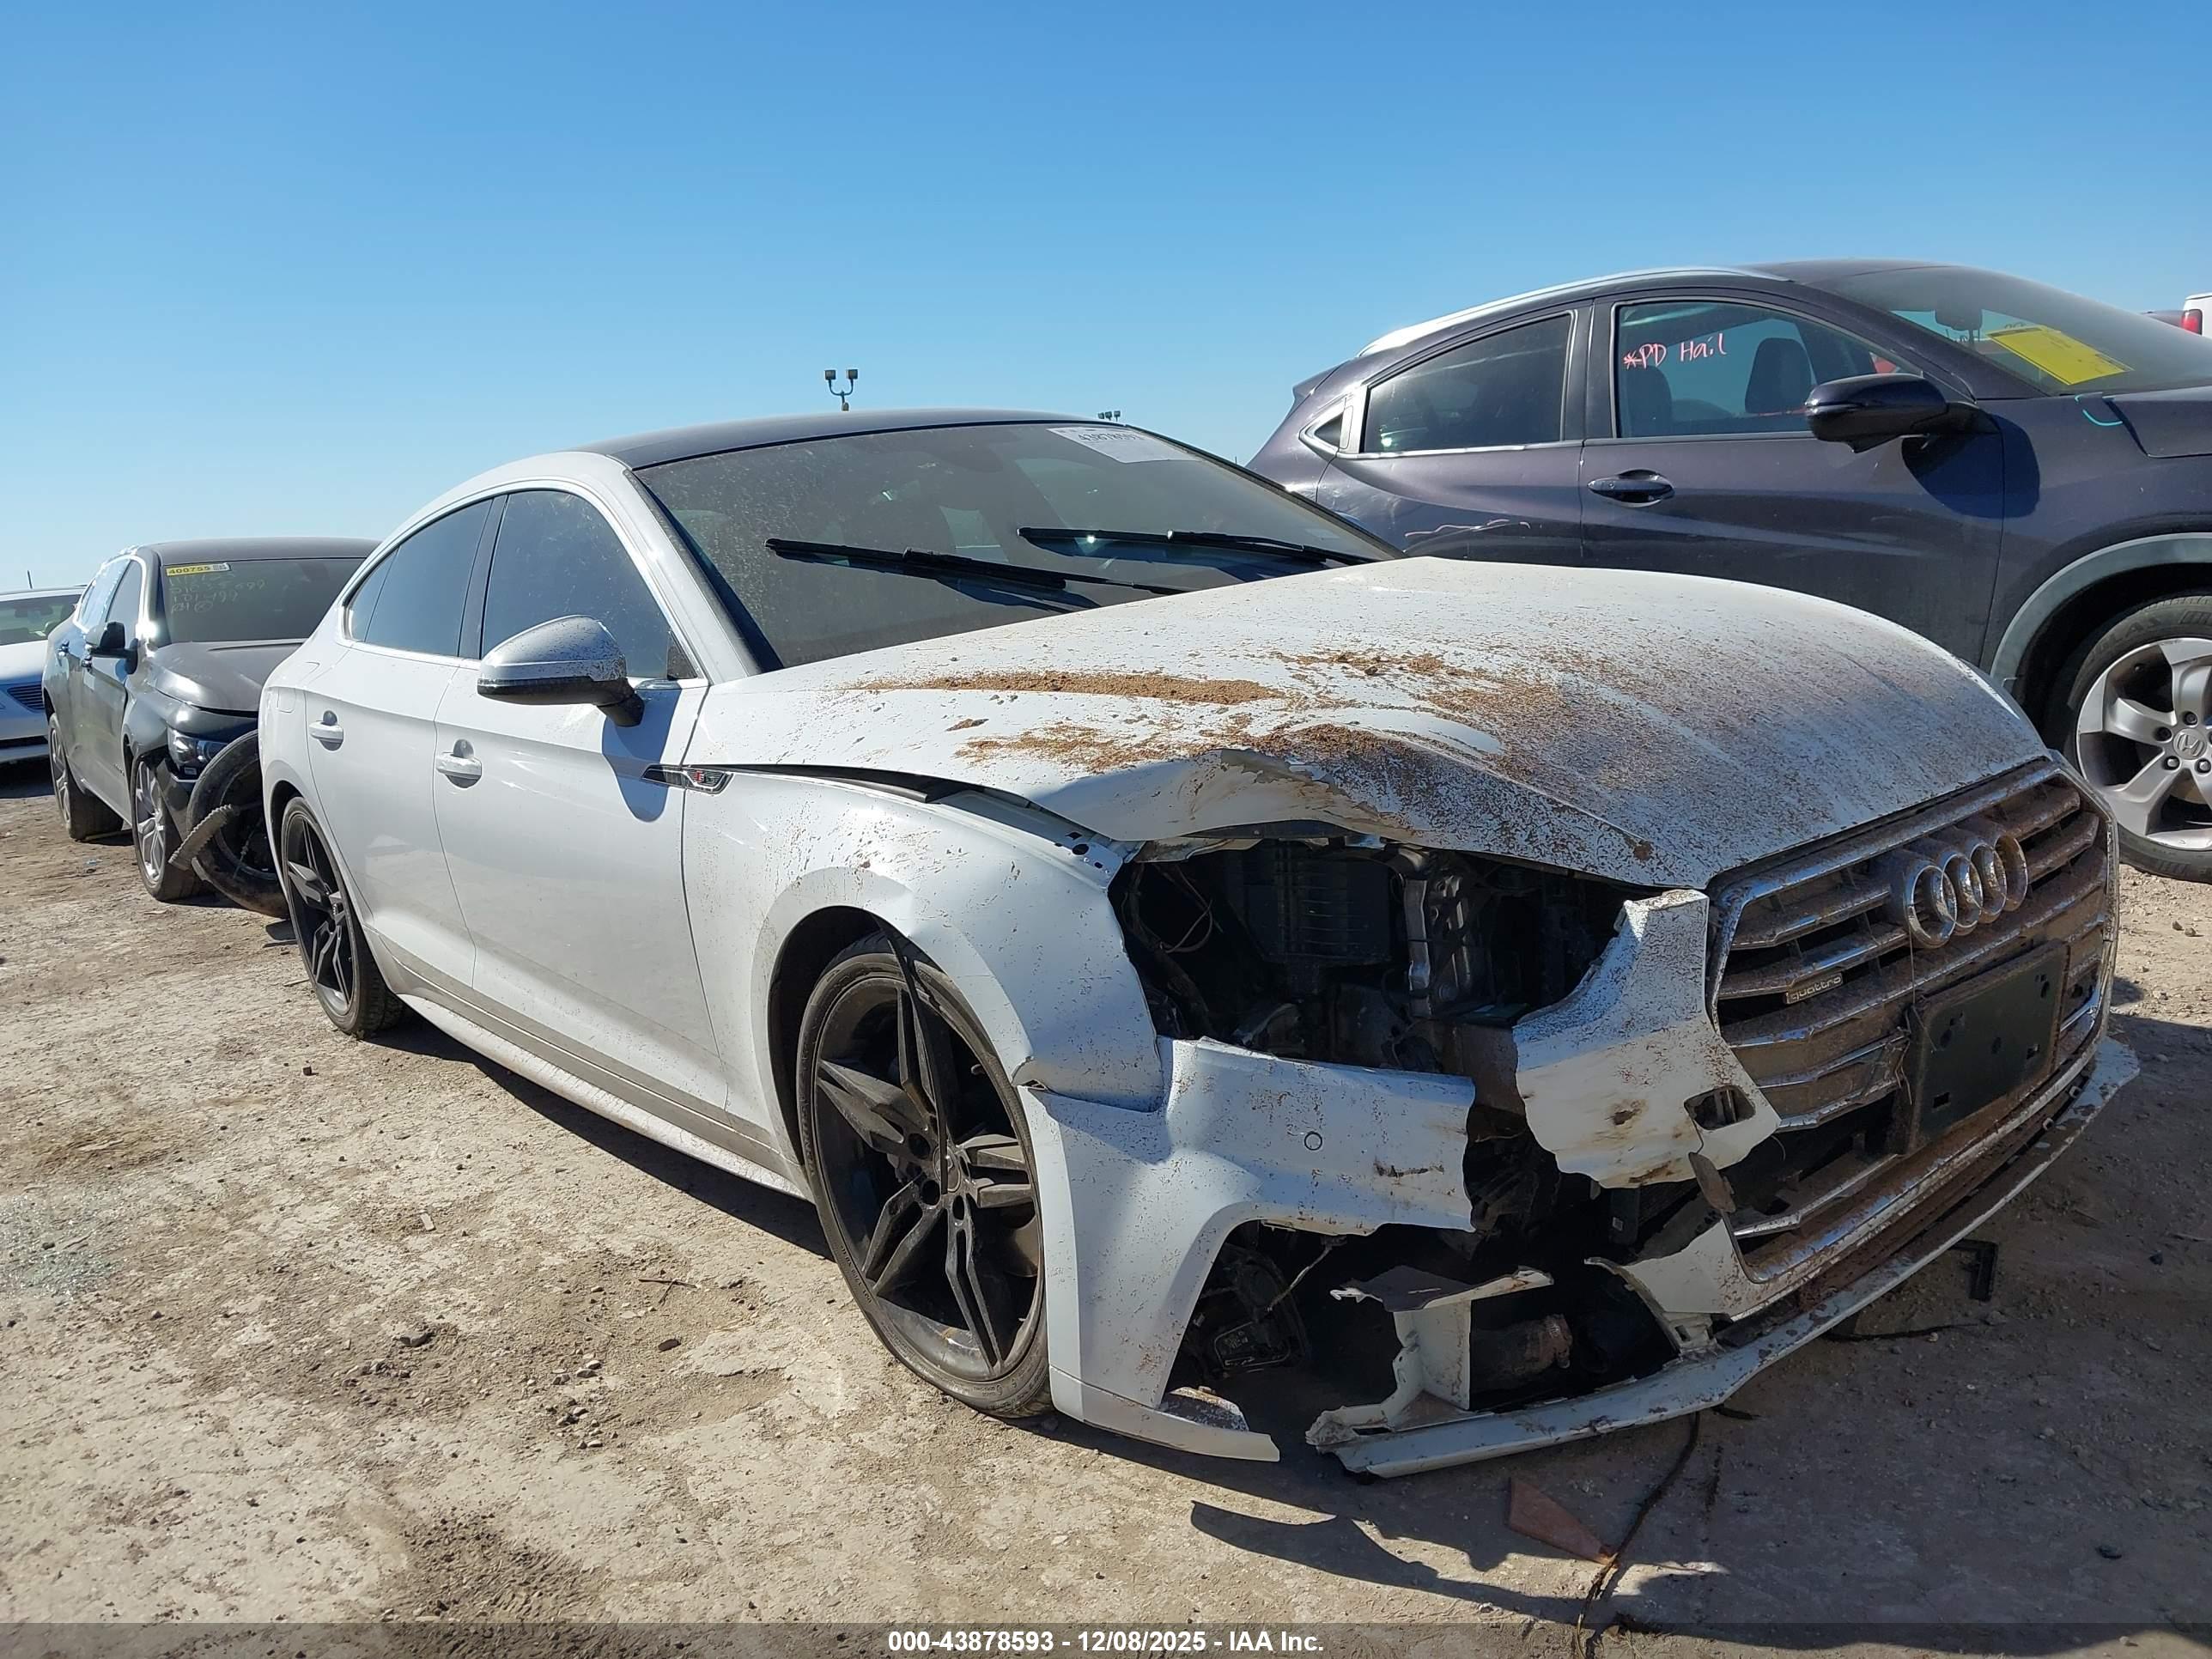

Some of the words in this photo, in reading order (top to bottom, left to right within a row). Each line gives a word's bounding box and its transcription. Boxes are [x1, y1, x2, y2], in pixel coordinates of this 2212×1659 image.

[1680, 332, 1728, 362] Hail
[168, 566, 211, 574] 400755
[1791, 975, 1842, 1000] quattro
